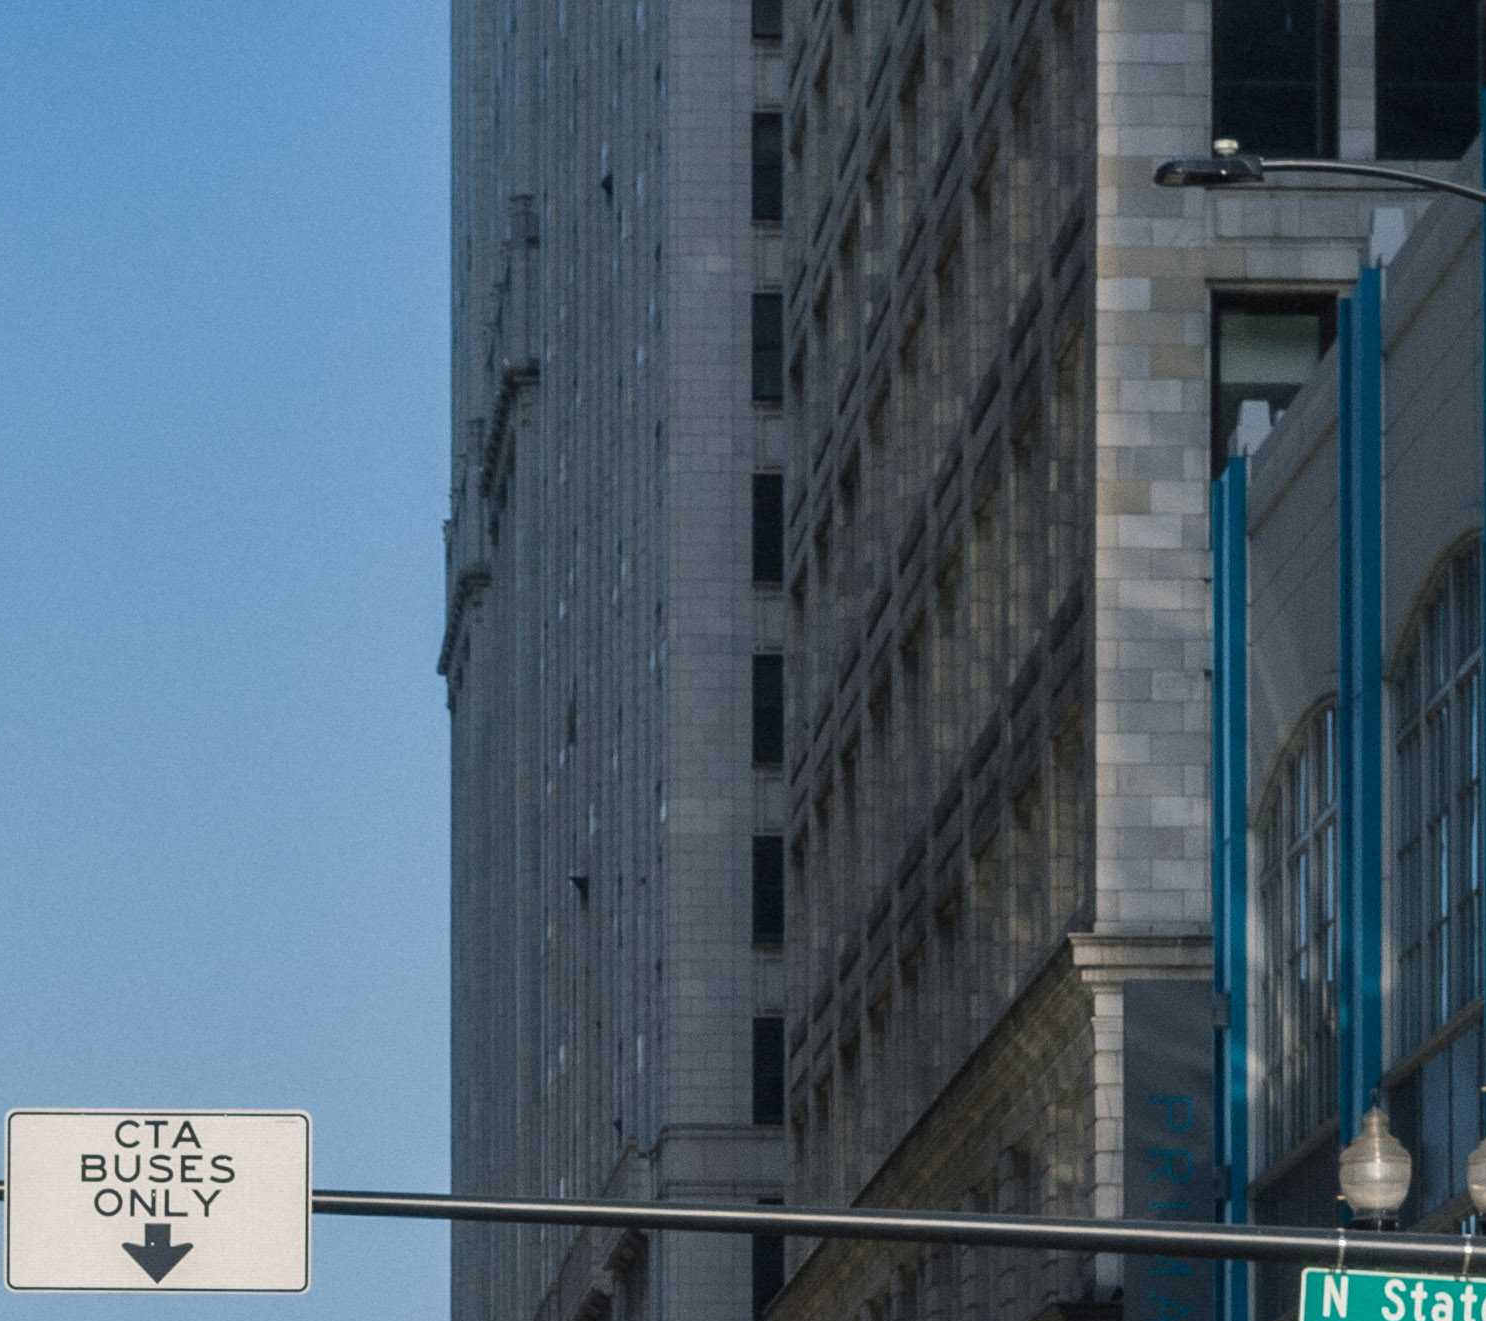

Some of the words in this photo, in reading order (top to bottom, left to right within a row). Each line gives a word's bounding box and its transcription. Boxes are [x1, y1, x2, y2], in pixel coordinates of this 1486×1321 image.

[115, 1120, 202, 1149] CTA
[81, 1154, 236, 1184] BUSES
[94, 1188, 223, 1217] ONLY
[1322, 1275, 1349, 1318] N
